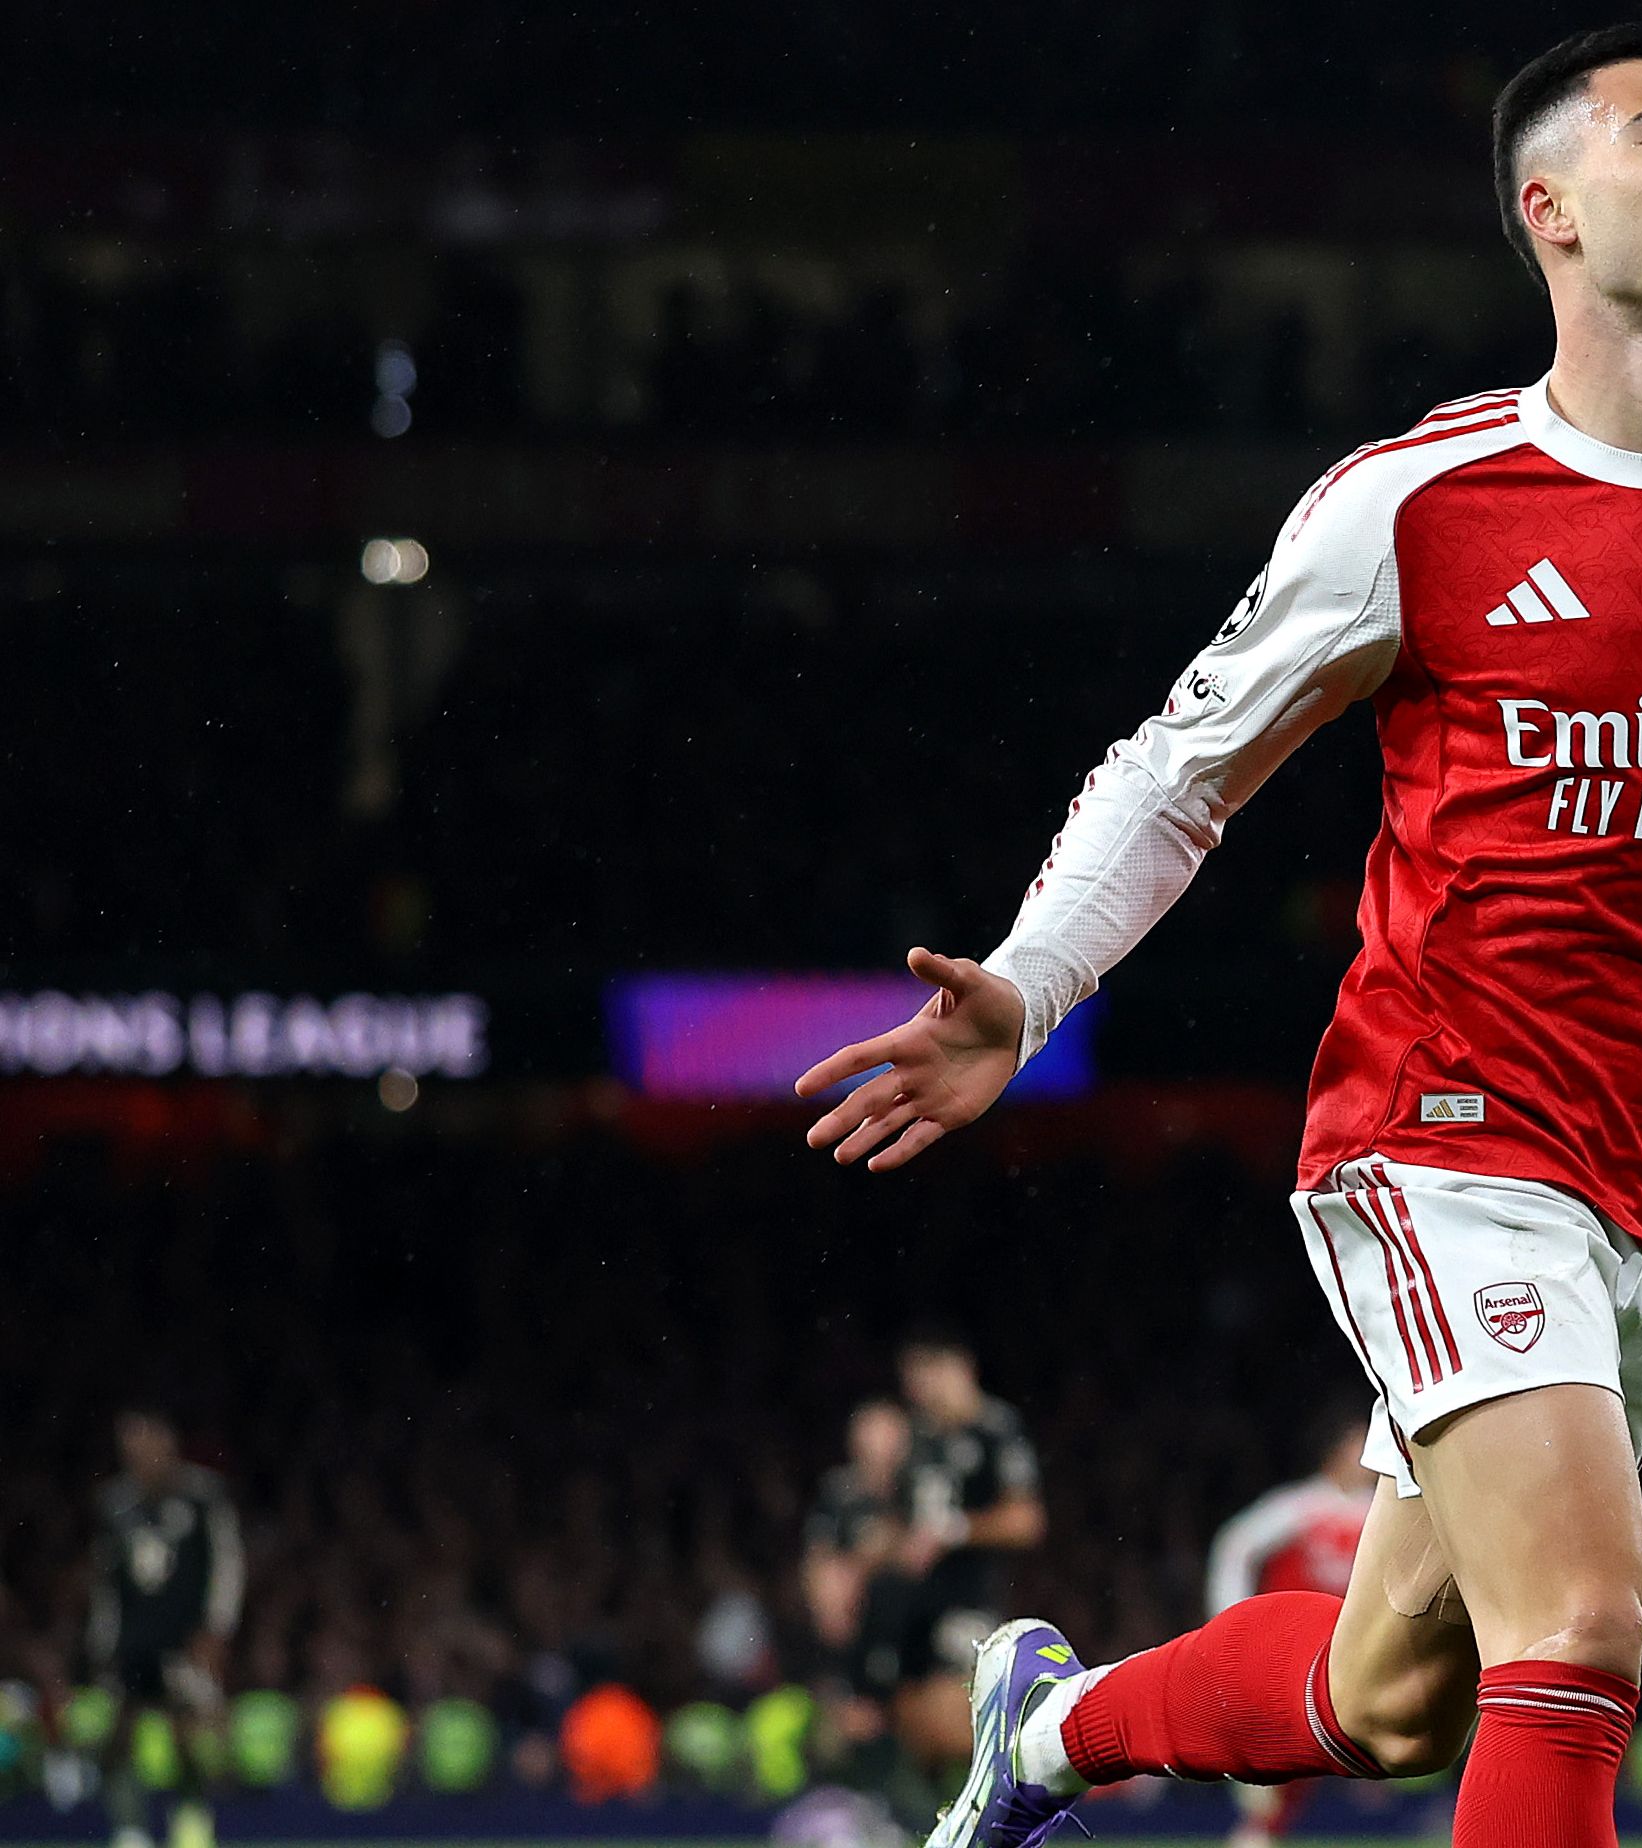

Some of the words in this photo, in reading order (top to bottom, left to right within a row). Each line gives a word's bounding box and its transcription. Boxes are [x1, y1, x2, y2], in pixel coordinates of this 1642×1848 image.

[1547, 777, 1624, 836] FLY
[190, 994, 487, 1075] LEAGUE
[1485, 1293, 1532, 1309] Arsenal
